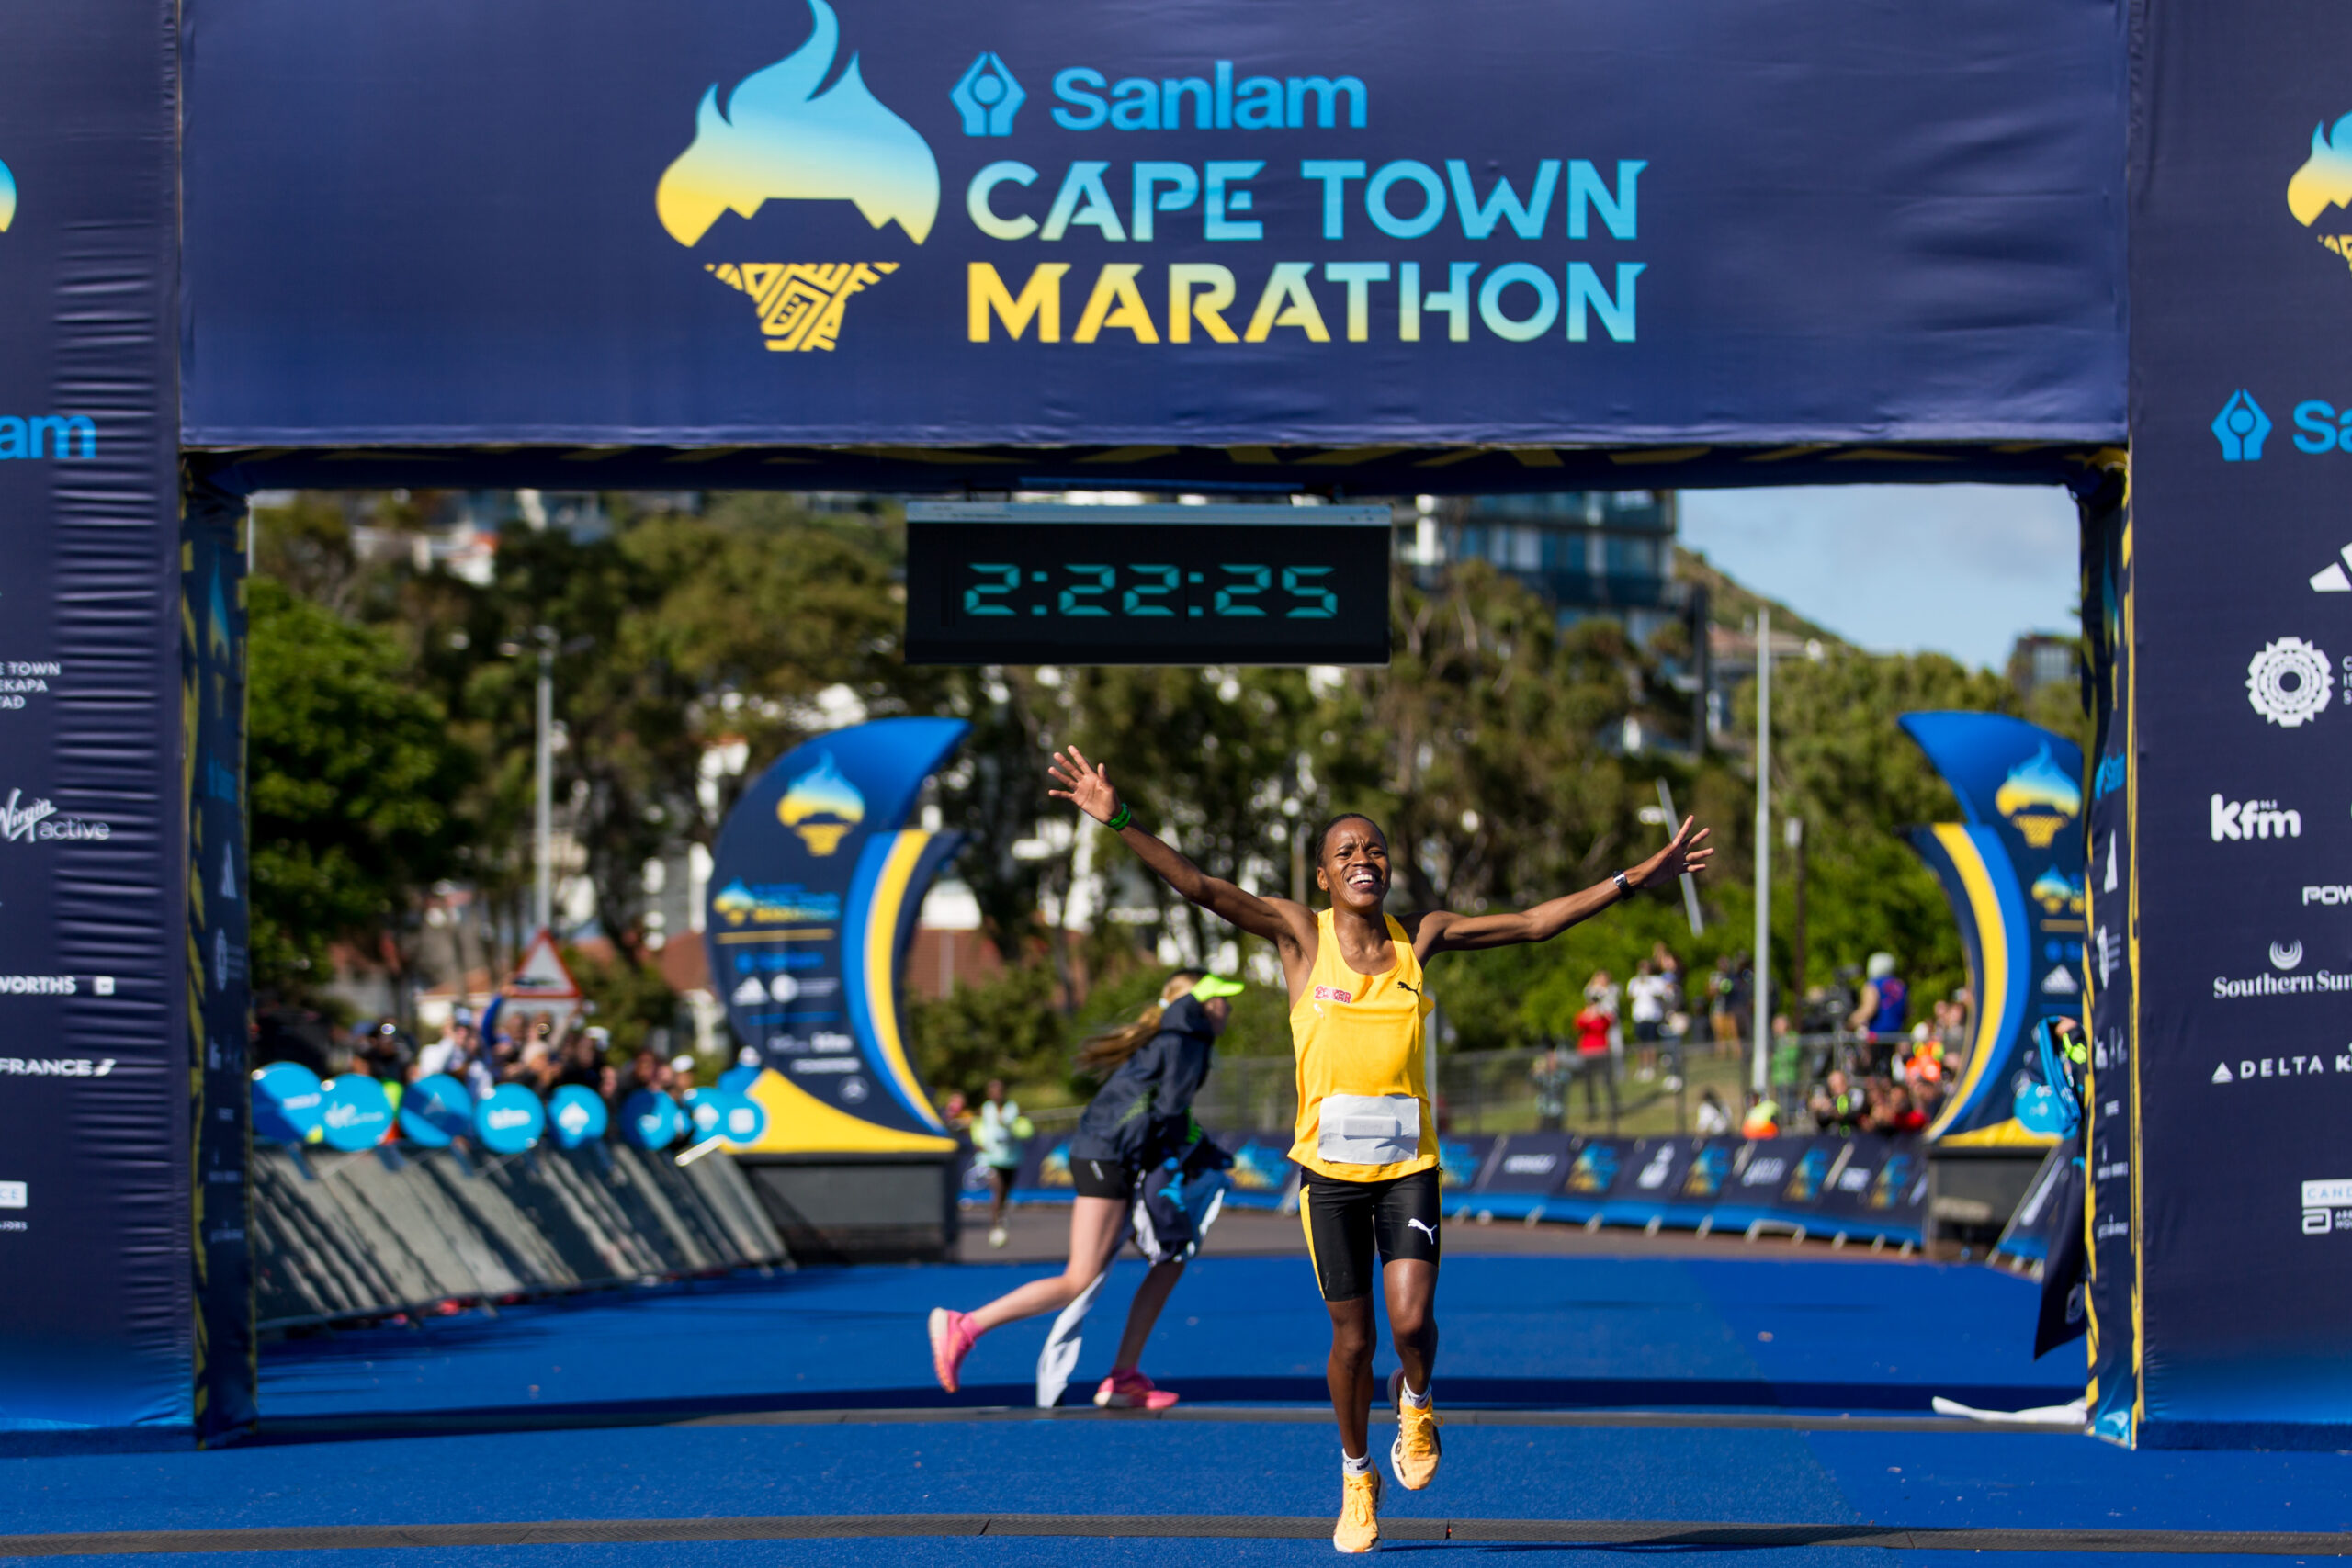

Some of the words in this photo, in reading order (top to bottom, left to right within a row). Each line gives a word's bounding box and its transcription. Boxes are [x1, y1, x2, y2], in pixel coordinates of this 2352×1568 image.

[1052, 60, 1367, 130] Sanlam
[967, 160, 1265, 242] CAPE
[1301, 159, 1648, 240] TOWN
[967, 261, 1647, 344] MARATHON
[963, 562, 1339, 619] 2:22:25
[7, 660, 62, 676] TOWN
[0, 694, 27, 710] AD
[0, 787, 58, 843] Virgin
[38, 817, 110, 840] active
[2210, 793, 2301, 842] kfm
[2212, 972, 2315, 999] Southern
[2315, 969, 2352, 992] Sun
[0, 1058, 93, 1077] FRANCE
[2240, 1055, 2324, 1079] DELTA
[2335, 1055, 2352, 1073] K
